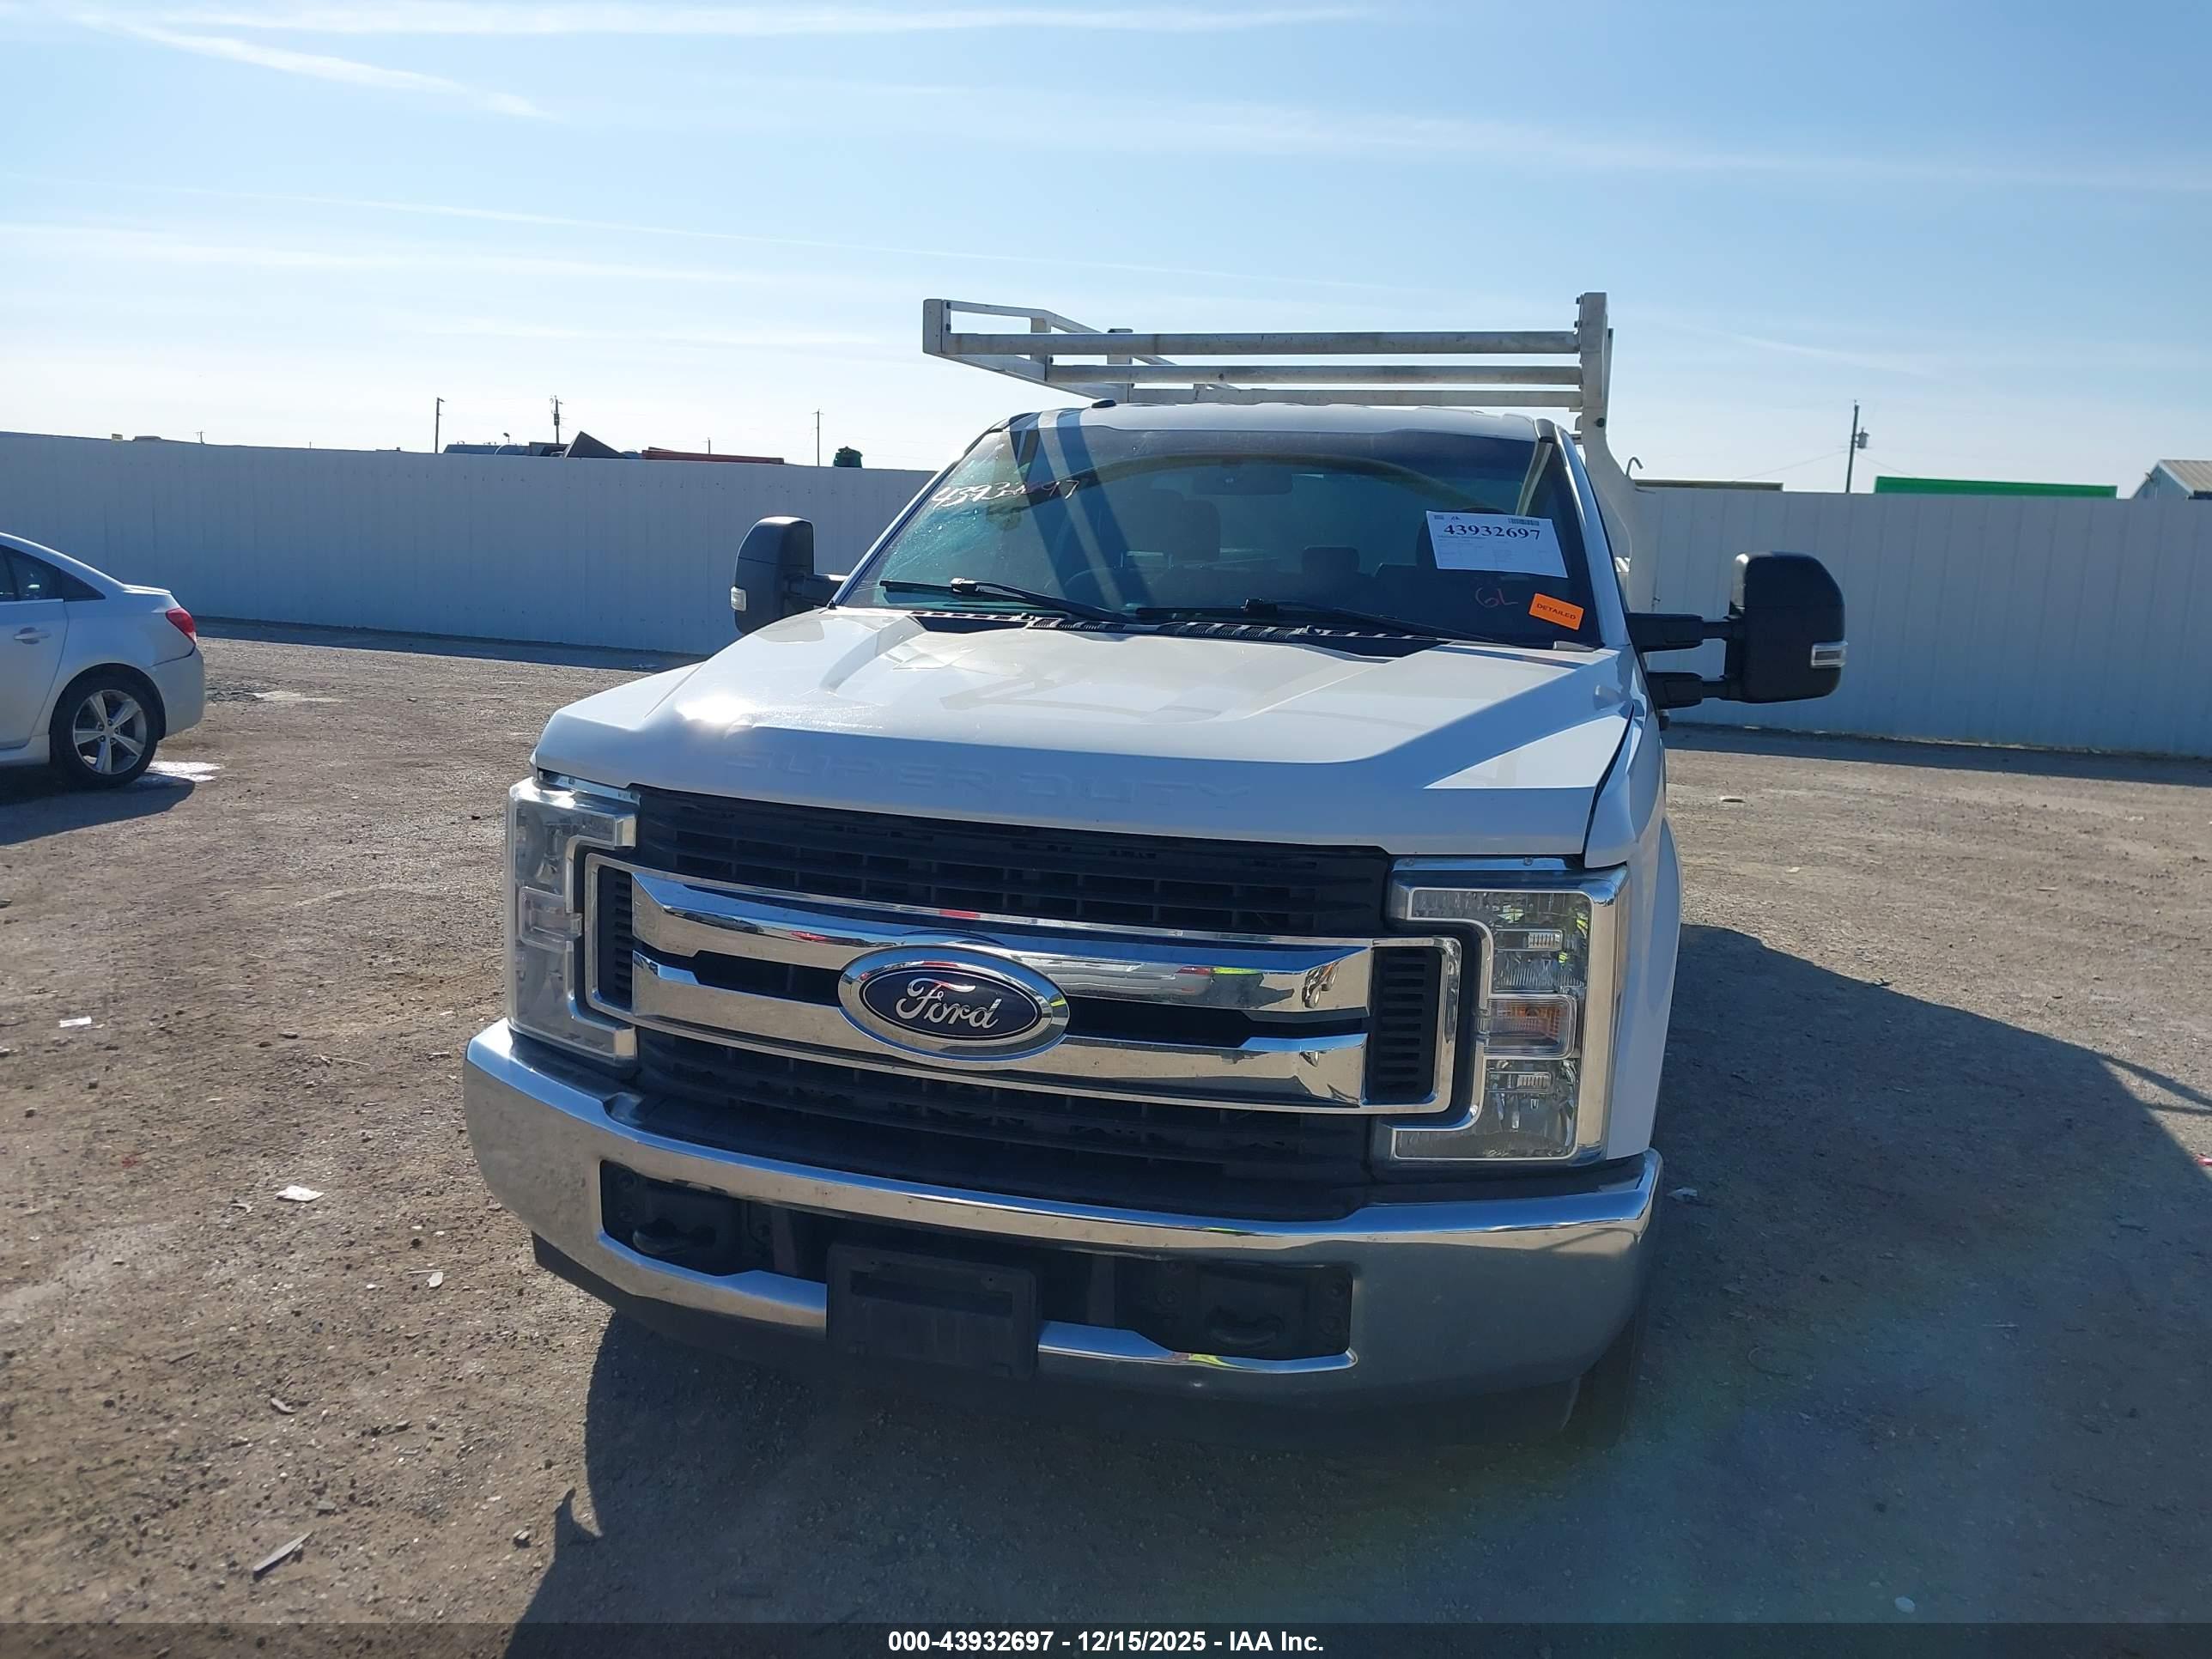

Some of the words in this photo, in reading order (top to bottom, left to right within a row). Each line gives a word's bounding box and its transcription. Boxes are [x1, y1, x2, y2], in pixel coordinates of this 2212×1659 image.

[1443, 524, 1540, 540] 43932697
[1536, 603, 1577, 620] DETAILED
[726, 750, 994, 792] SUPER
[1019, 773, 1251, 809] DUTY
[896, 977, 1002, 1029] Ford
